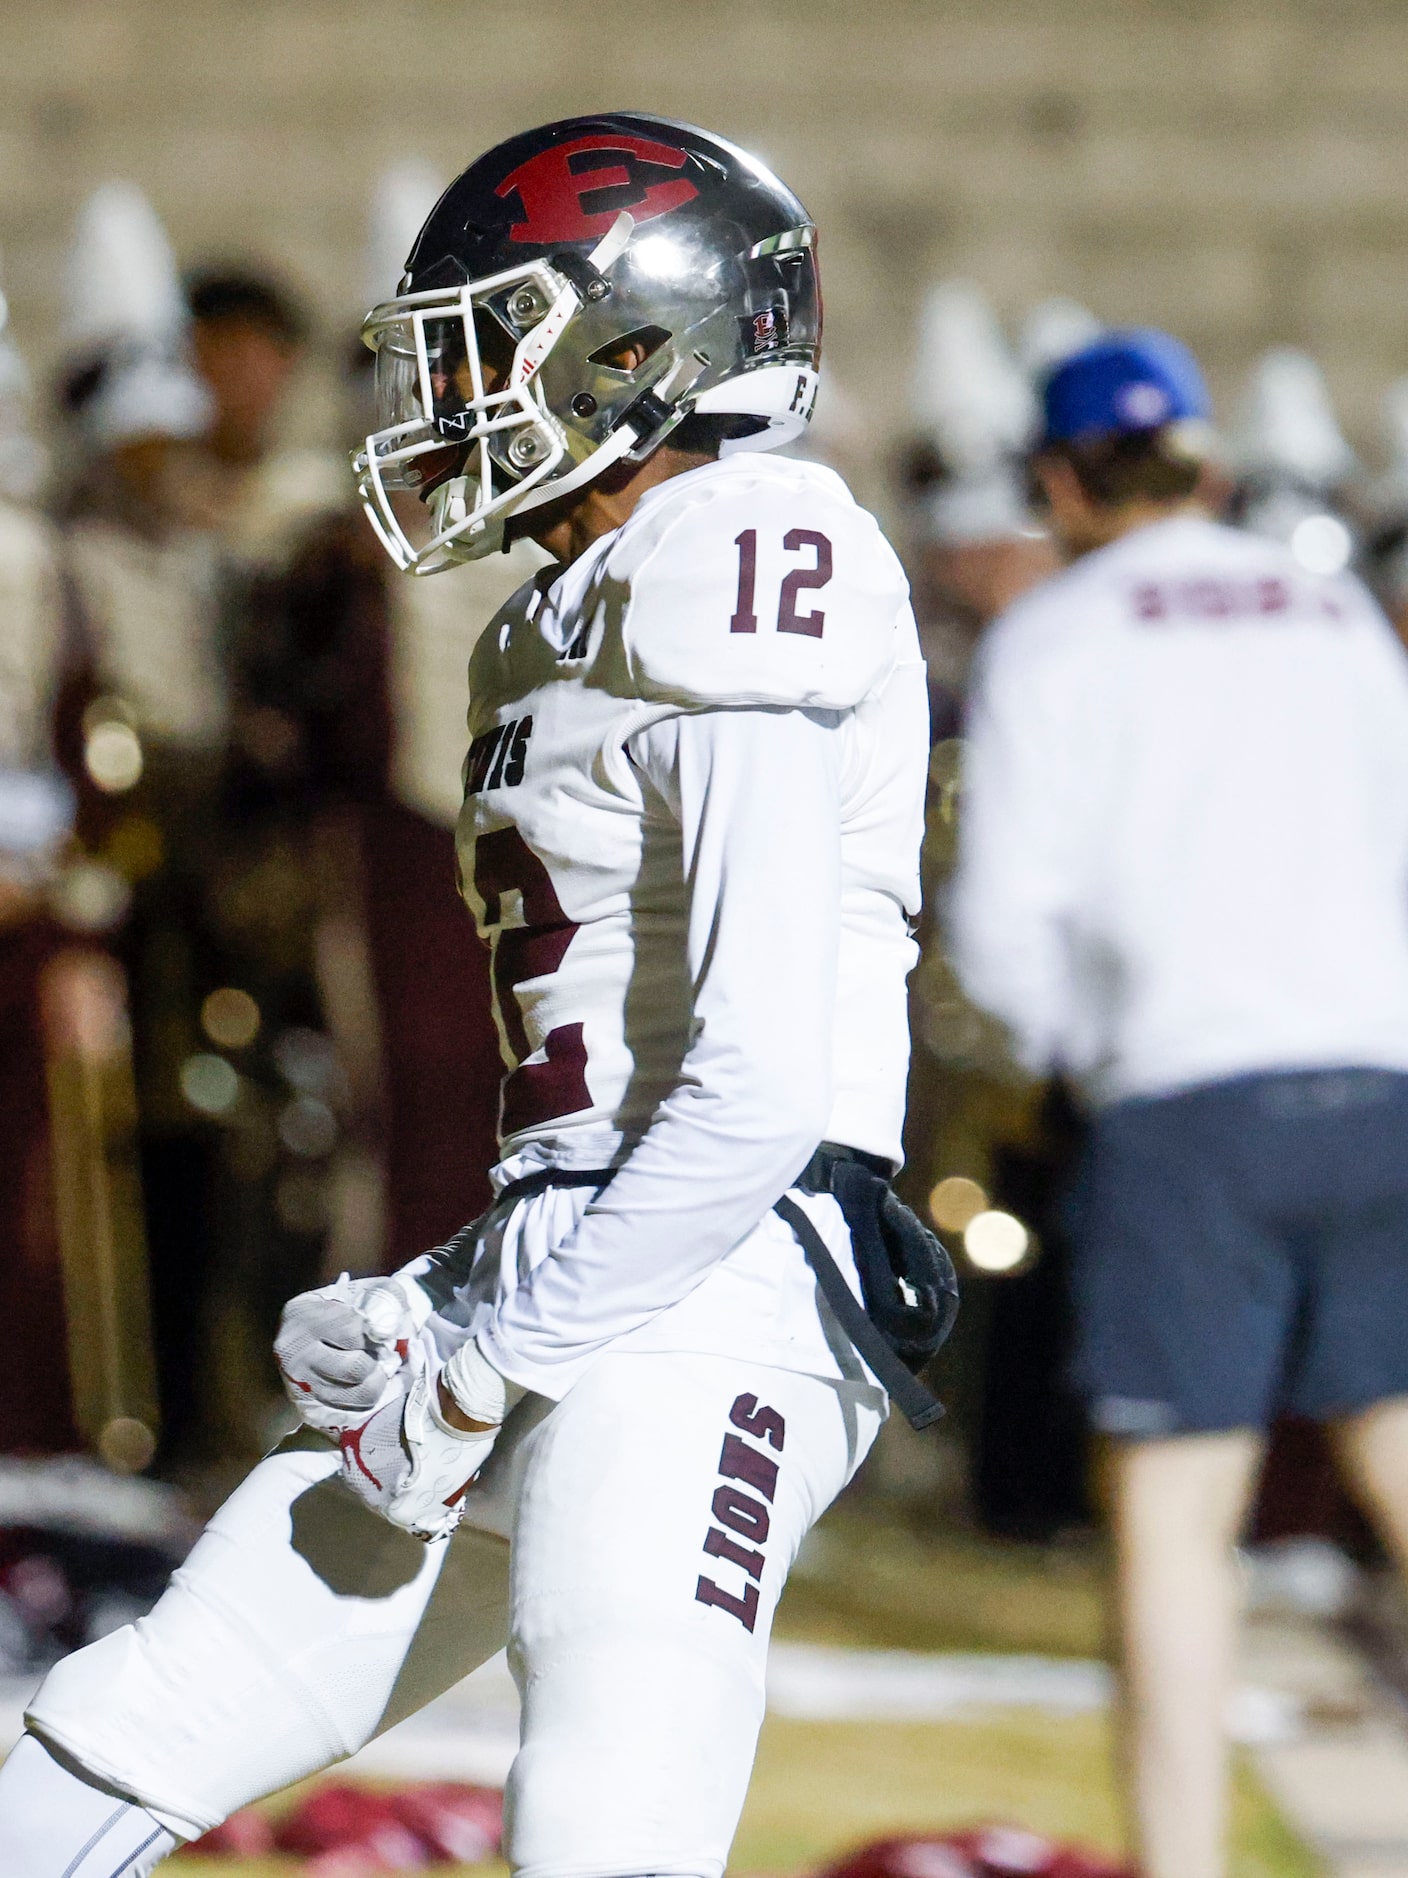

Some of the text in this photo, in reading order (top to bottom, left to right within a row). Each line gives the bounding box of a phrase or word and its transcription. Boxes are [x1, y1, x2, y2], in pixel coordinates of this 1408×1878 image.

[495, 134, 700, 244] E
[730, 528, 833, 639] 12
[694, 1392, 785, 1635] LIONS
